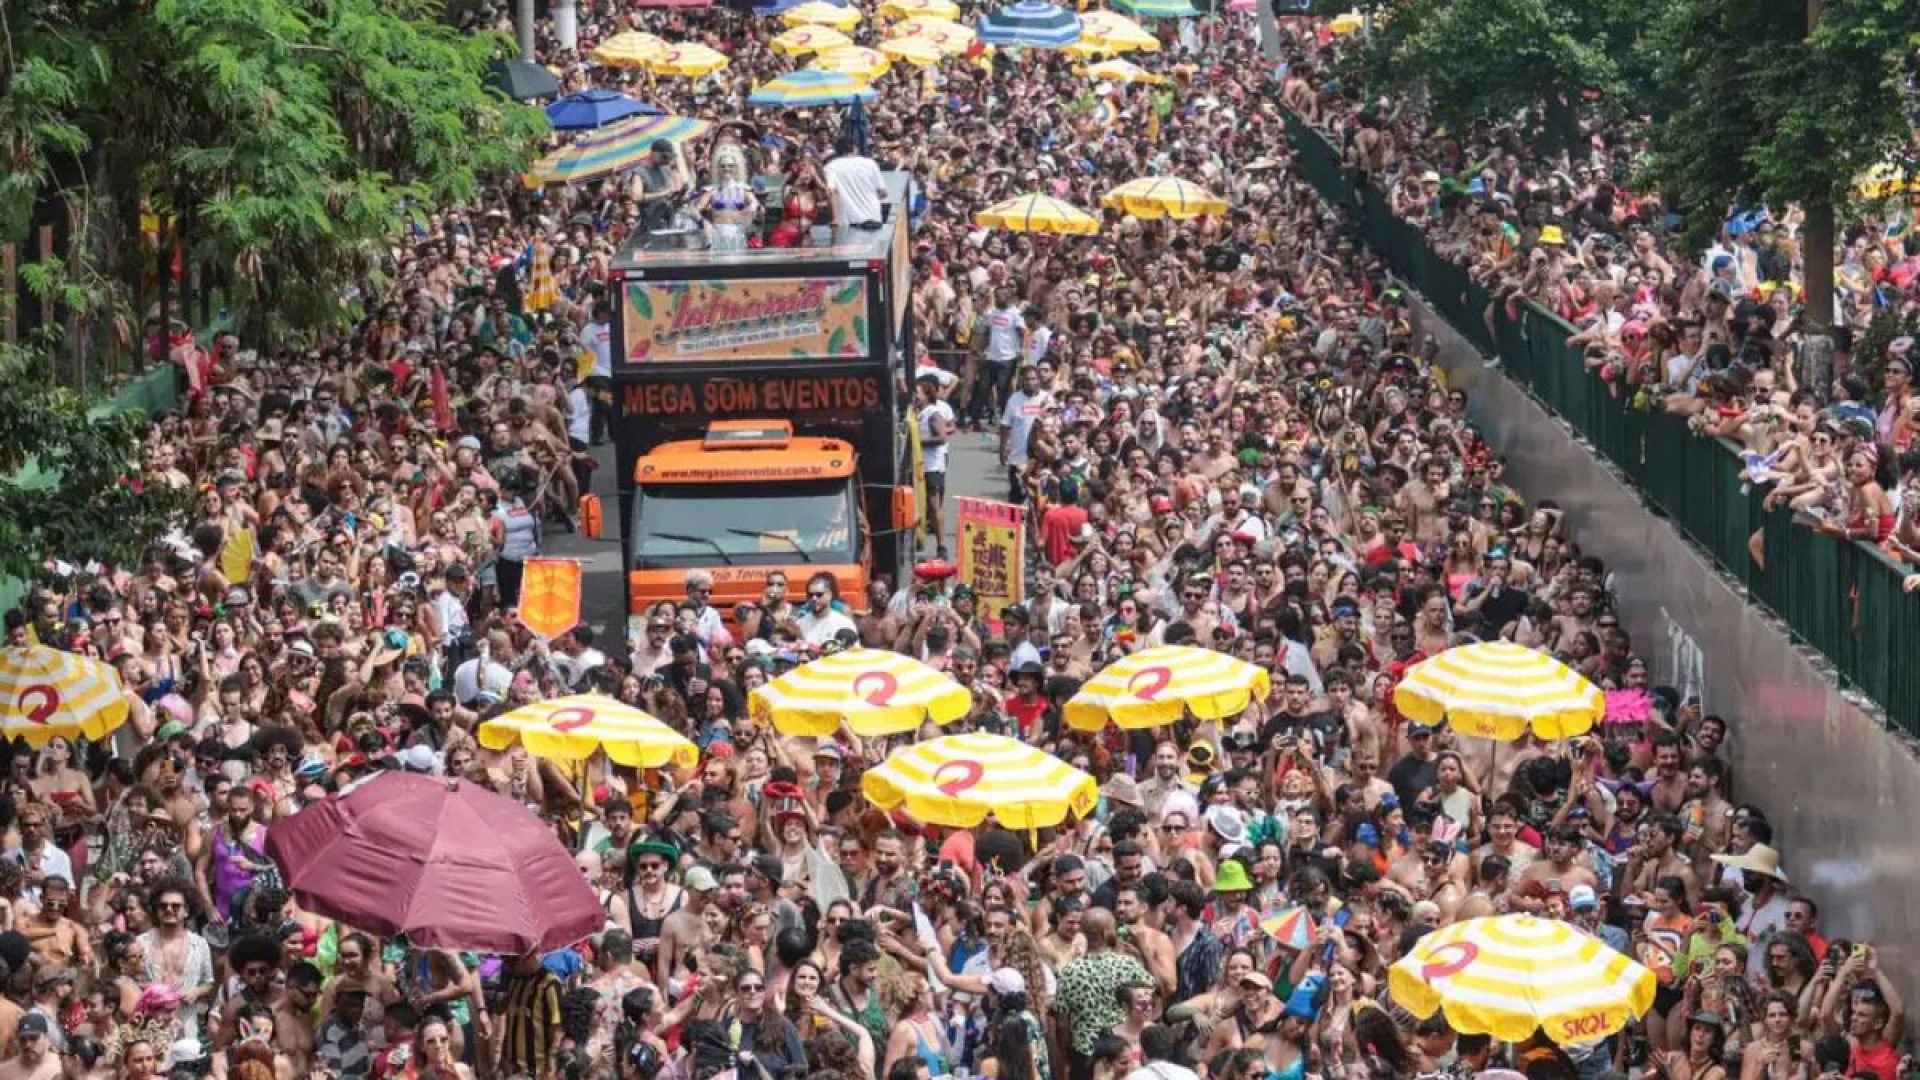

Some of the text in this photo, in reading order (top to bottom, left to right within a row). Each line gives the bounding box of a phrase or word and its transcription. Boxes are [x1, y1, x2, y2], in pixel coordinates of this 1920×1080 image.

[624, 377, 879, 414] MEGA SOM EVENTOS
[661, 466, 822, 480] www.megasomeventos.com.br
[1562, 1012, 1610, 1039] SKOL
